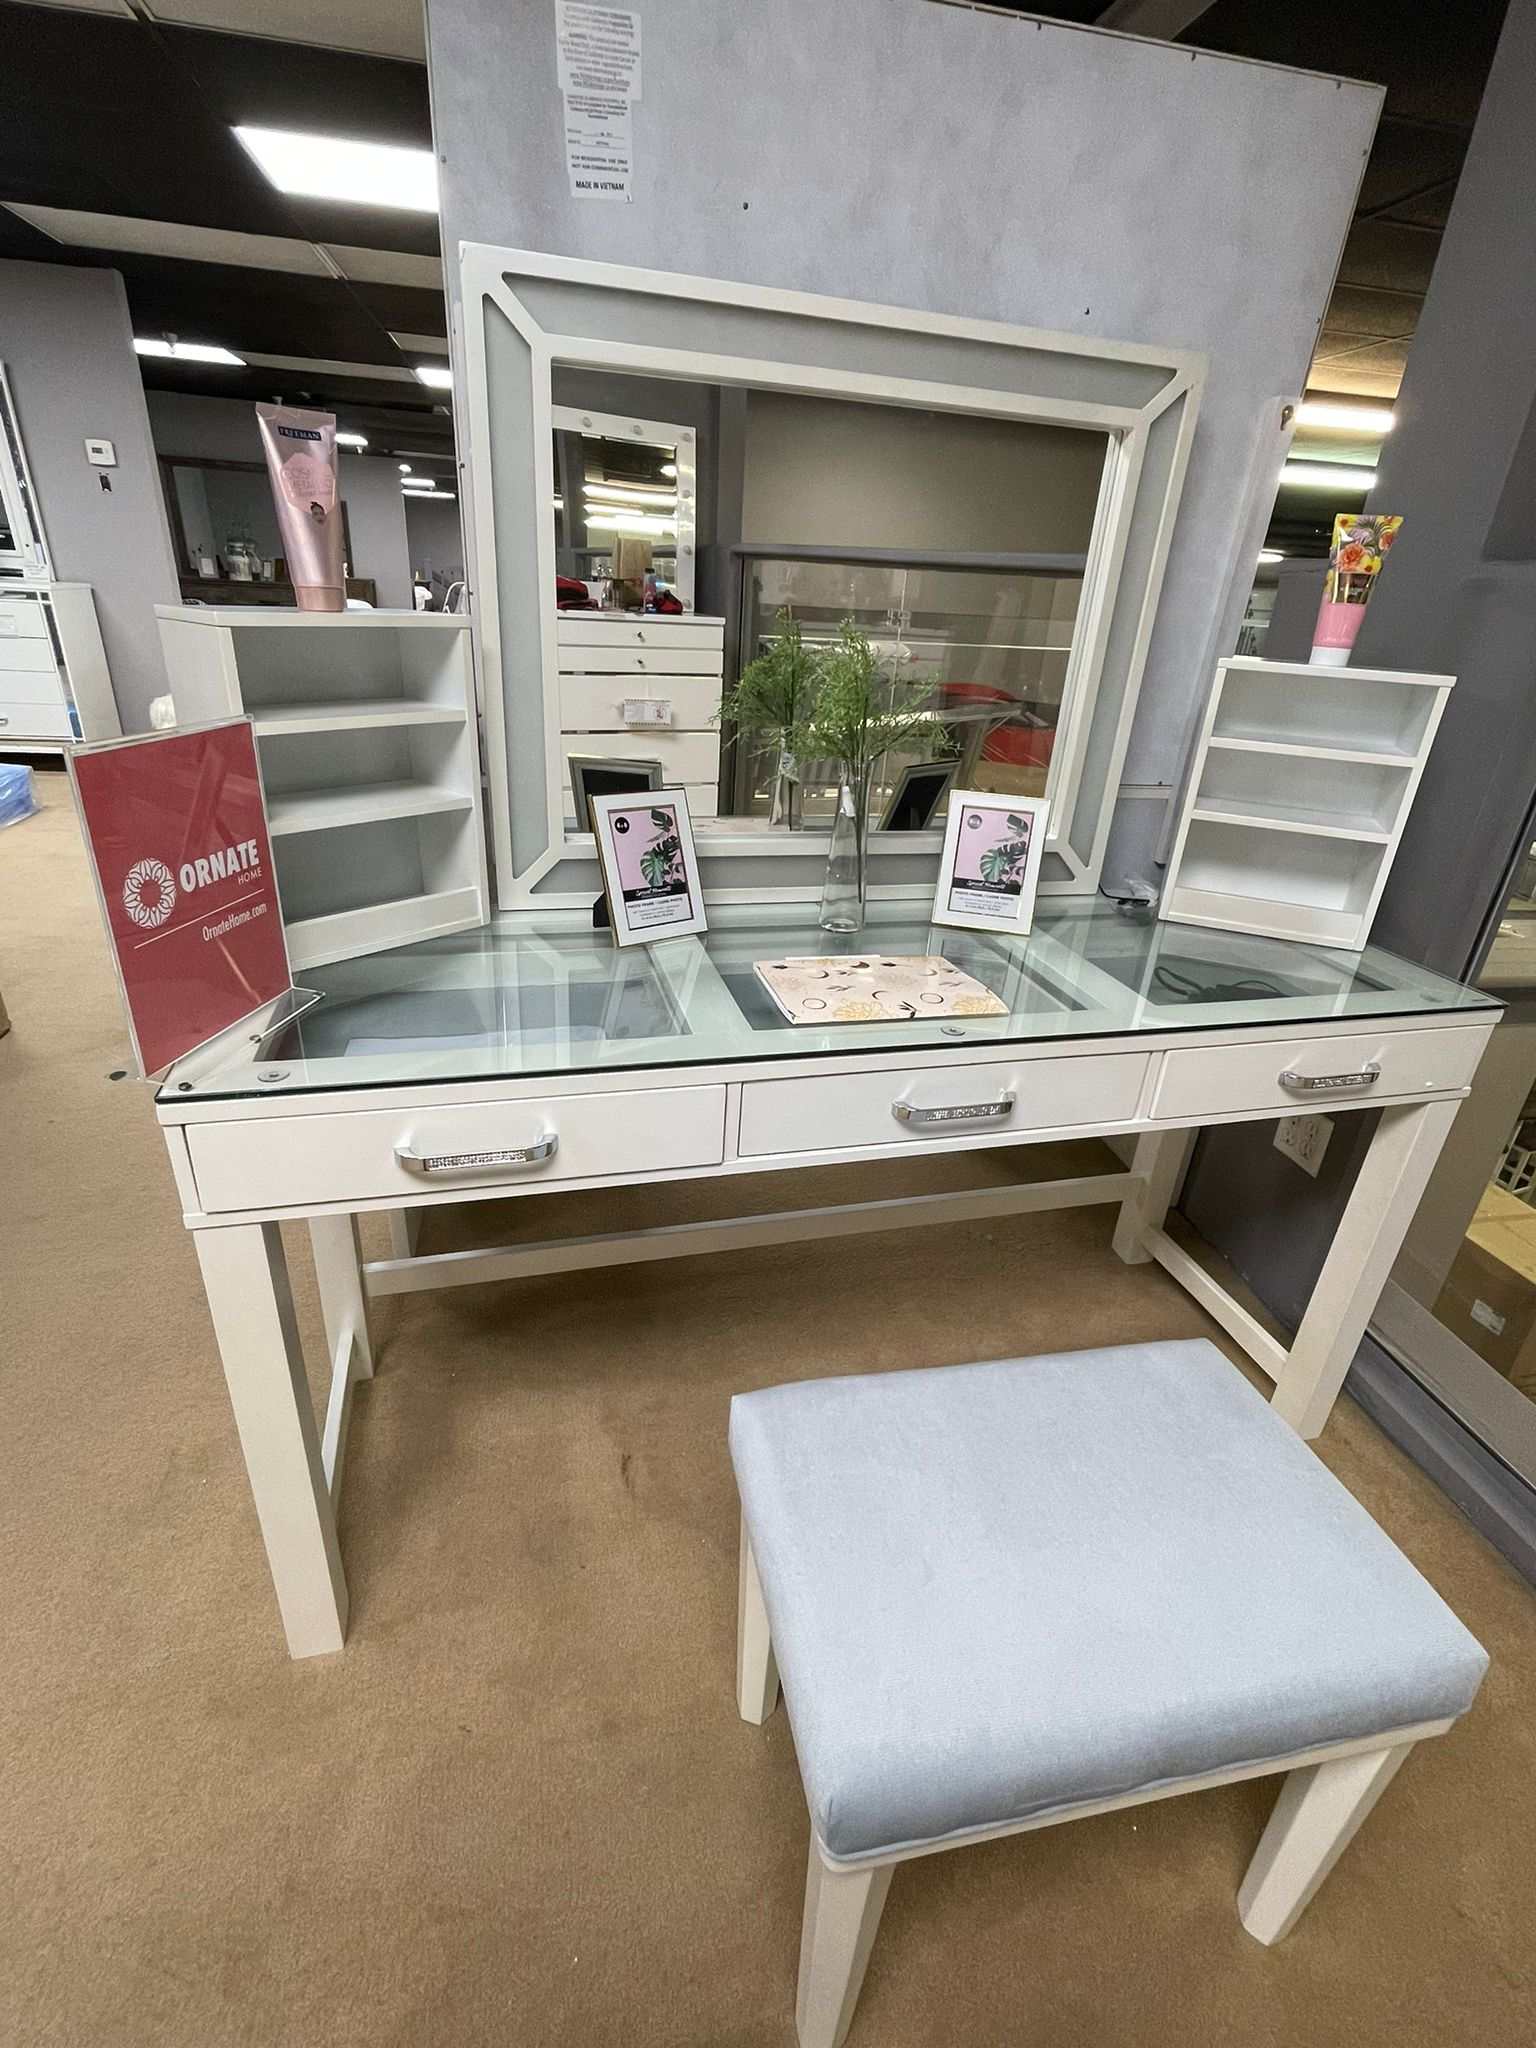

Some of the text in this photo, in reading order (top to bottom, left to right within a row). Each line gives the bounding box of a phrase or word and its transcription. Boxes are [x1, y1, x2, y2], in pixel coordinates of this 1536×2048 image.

[576, 180, 625, 190] MADE IN VIETNAM
[180, 839, 259, 893] ORNATE
[238, 867, 263, 885] HOME
[202, 903, 267, 941] OrnateHome.com
